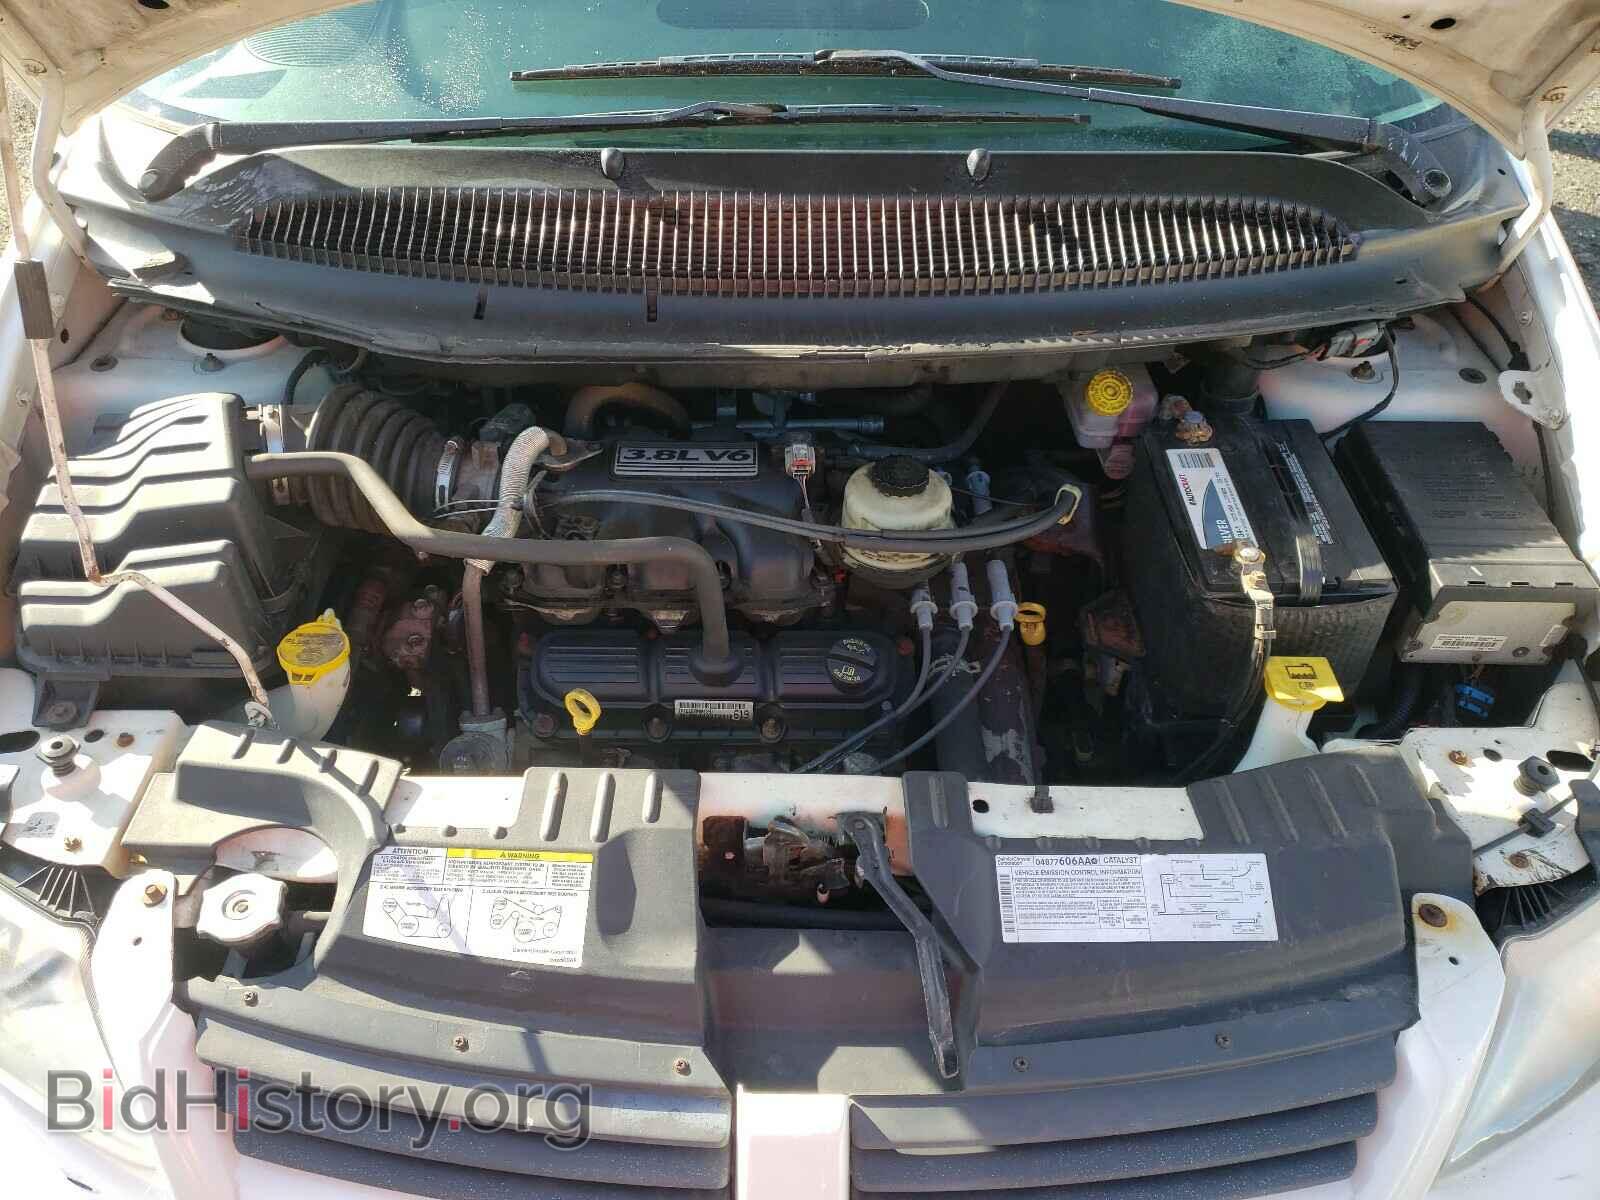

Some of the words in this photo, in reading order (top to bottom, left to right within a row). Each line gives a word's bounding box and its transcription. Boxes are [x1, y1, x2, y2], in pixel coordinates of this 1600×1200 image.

[623, 449, 699, 461] 3.8L
[704, 450, 751, 461] V6
[392, 847, 429, 855] ATTENTION
[1103, 856, 1137, 864] CATALYST
